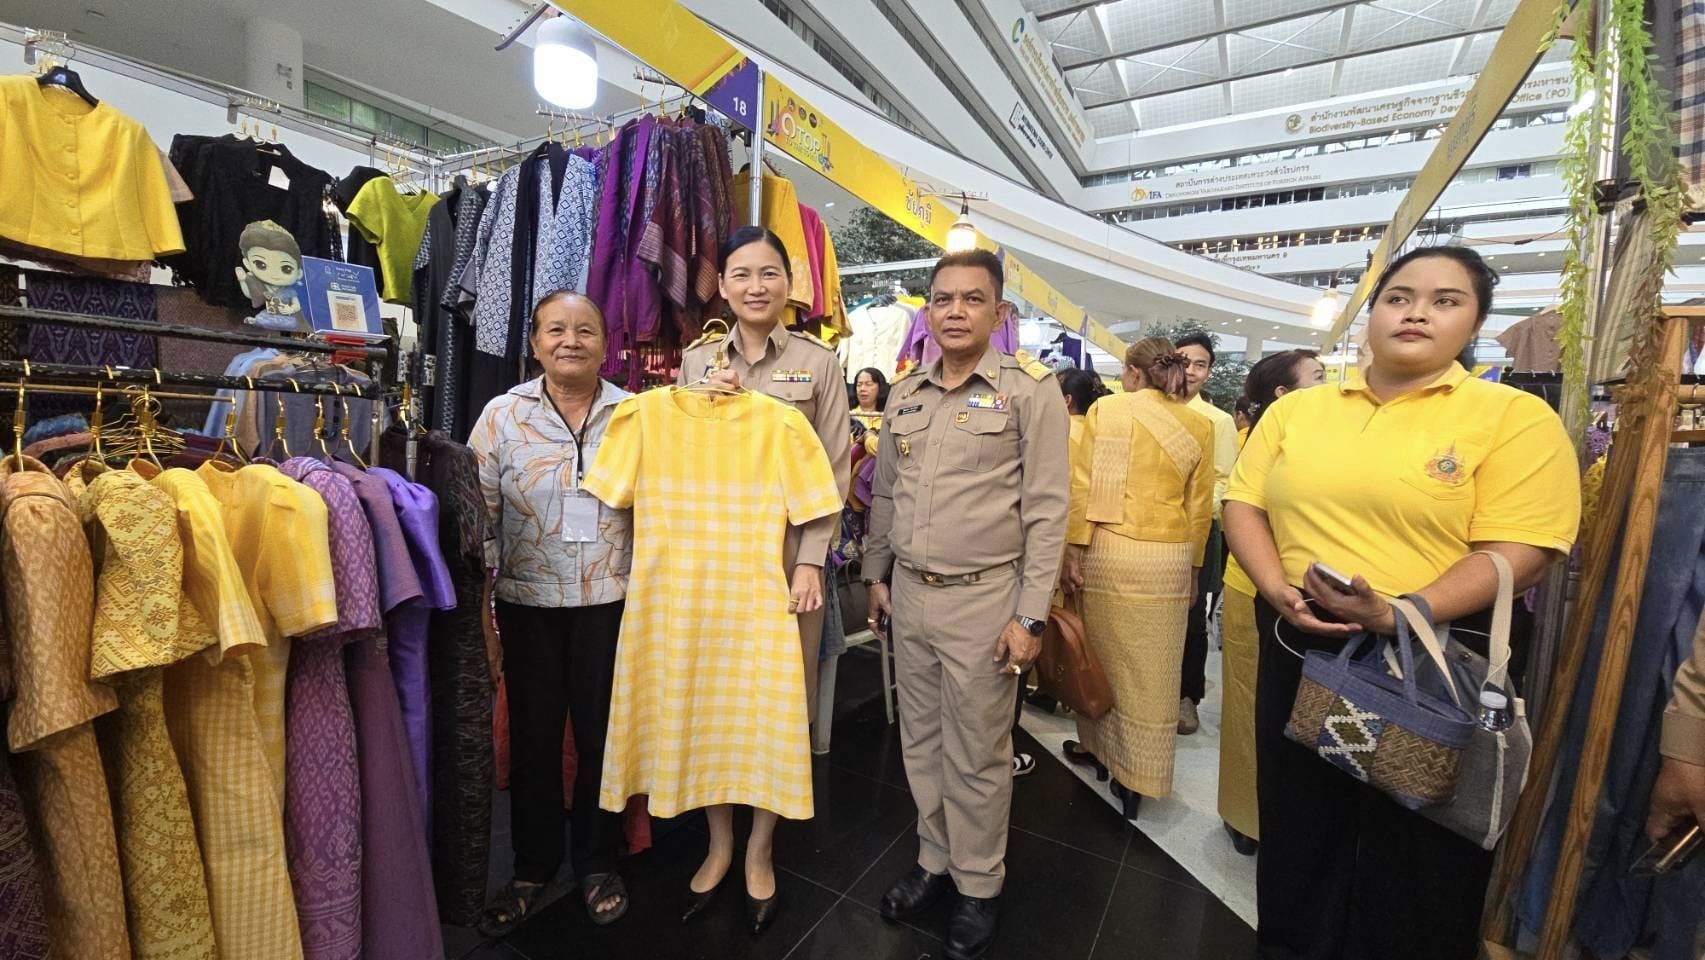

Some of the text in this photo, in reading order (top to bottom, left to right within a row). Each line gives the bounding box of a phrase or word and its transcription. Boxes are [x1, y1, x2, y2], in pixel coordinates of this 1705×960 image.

[732, 96, 747, 116] 18
[1309, 114, 1389, 134] Biodiversity-Based
[1392, 107, 1436, 121] Economy
[1440, 104, 1460, 113] Dev
[1546, 87, 1571, 99] (PO)
